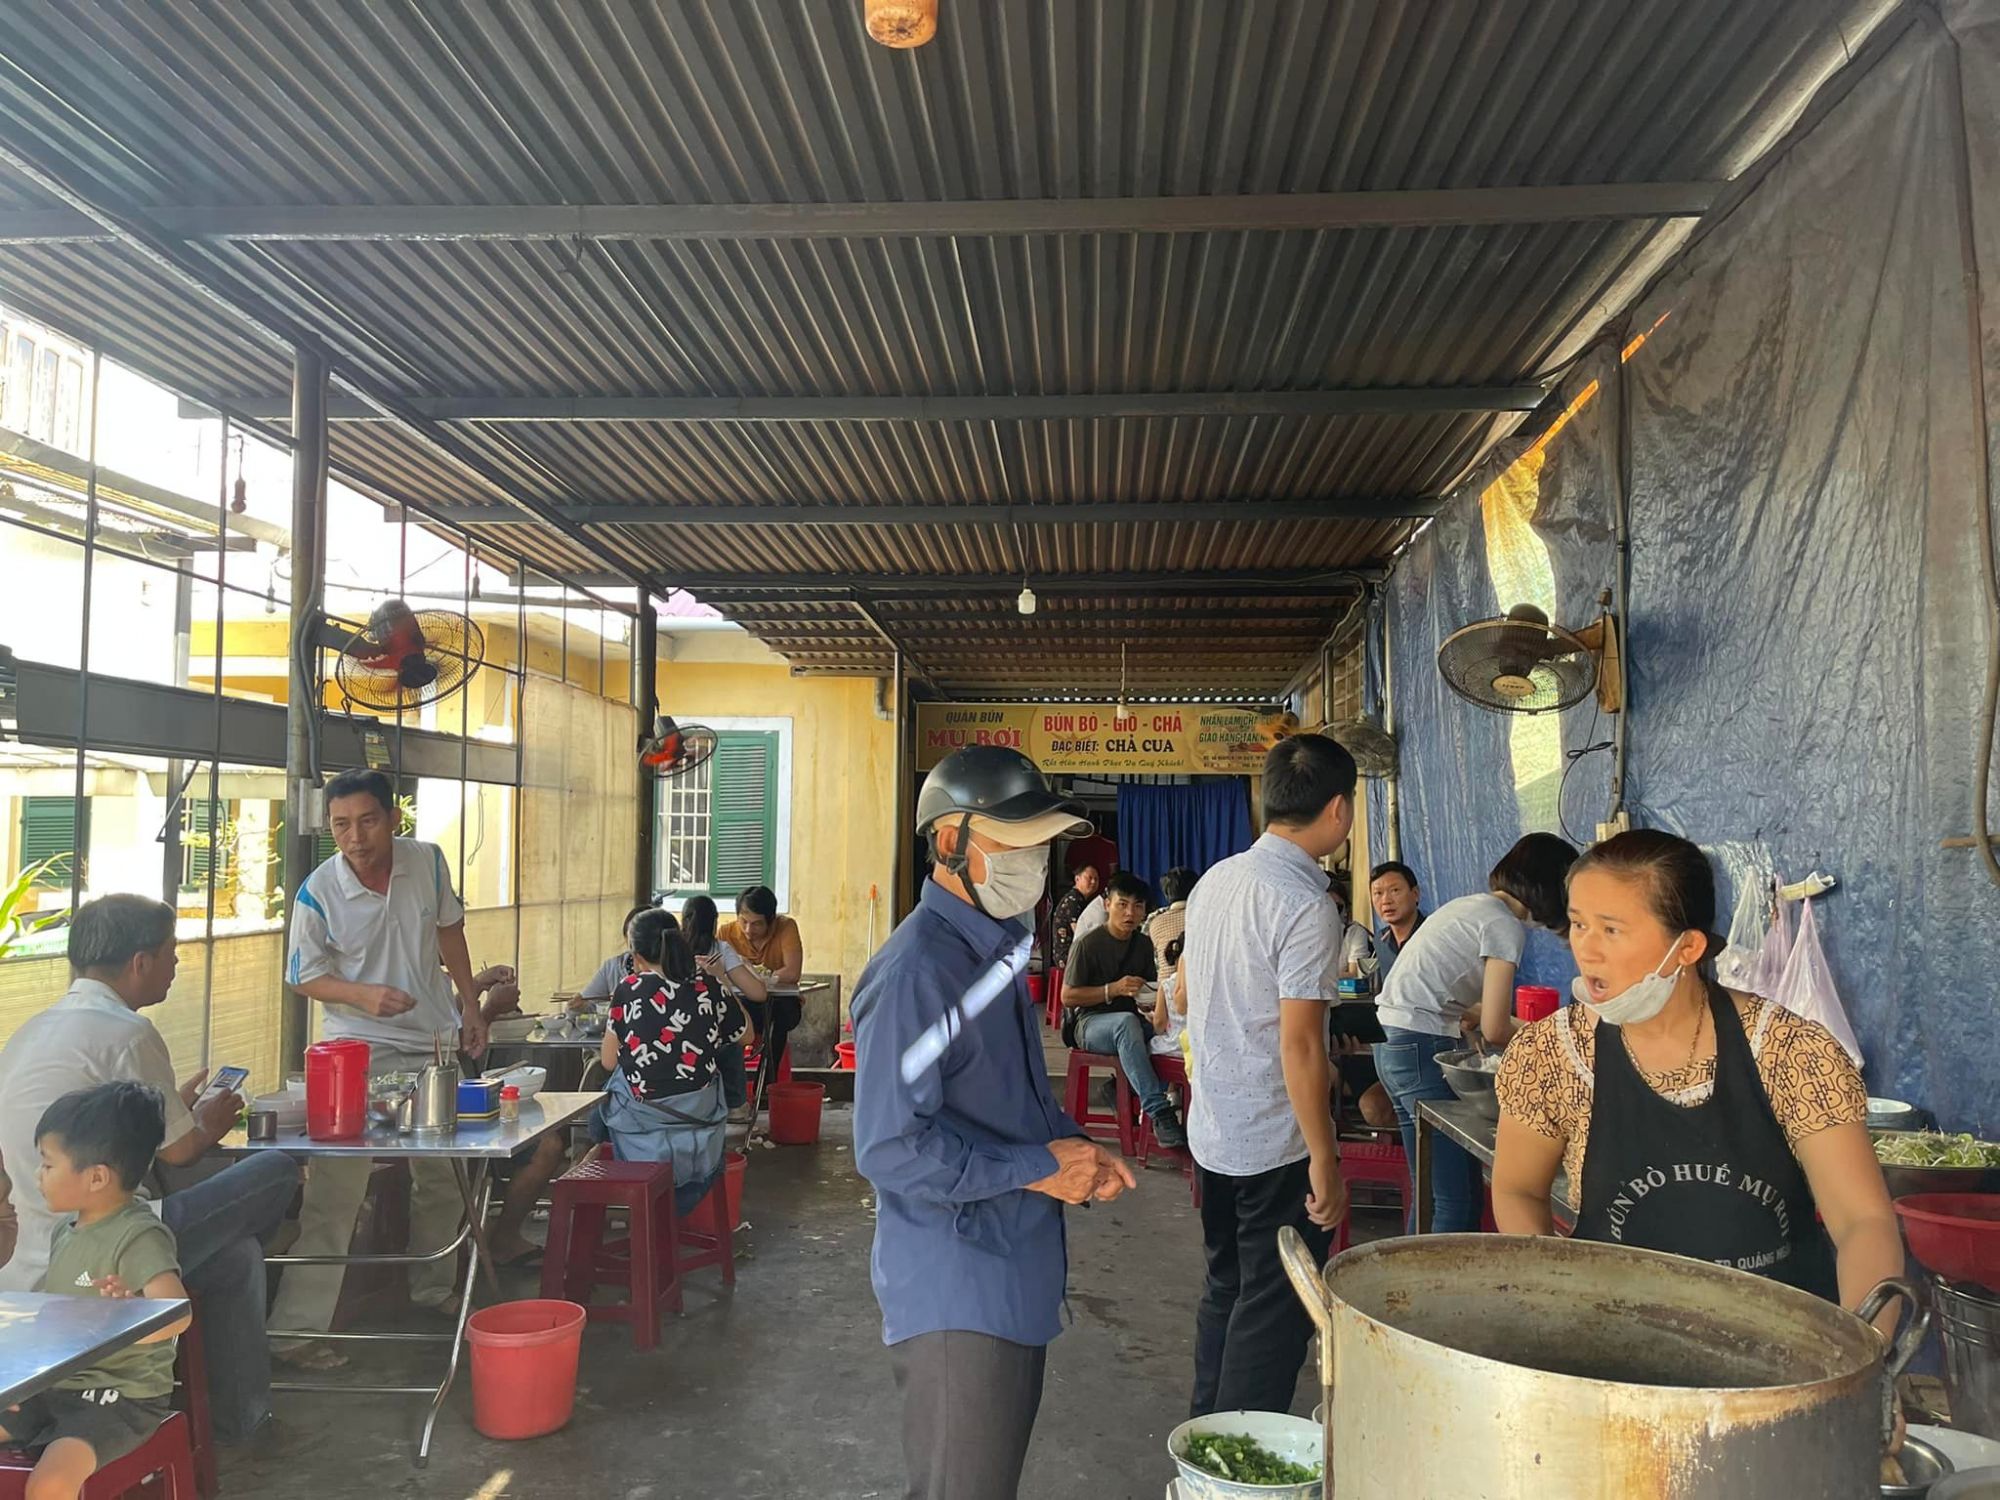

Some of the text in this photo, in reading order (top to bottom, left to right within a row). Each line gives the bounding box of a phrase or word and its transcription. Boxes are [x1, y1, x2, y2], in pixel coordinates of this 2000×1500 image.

[979, 709, 1004, 723] BÚN
[1044, 712, 1074, 732] BÚN
[1078, 711, 1098, 732] BÒ
[1113, 712, 1138, 732] GIÒ
[1152, 711, 1182, 732] CHẢ
[926, 729, 966, 751] MỤ
[1105, 734, 1138, 753] CHẢ
[1141, 739, 1175, 753] CUA
[1628, 1166, 1666, 1197] BÒ
[1672, 1163, 1731, 1186] HUẾ
[1738, 1174, 1778, 1206] MỤ
